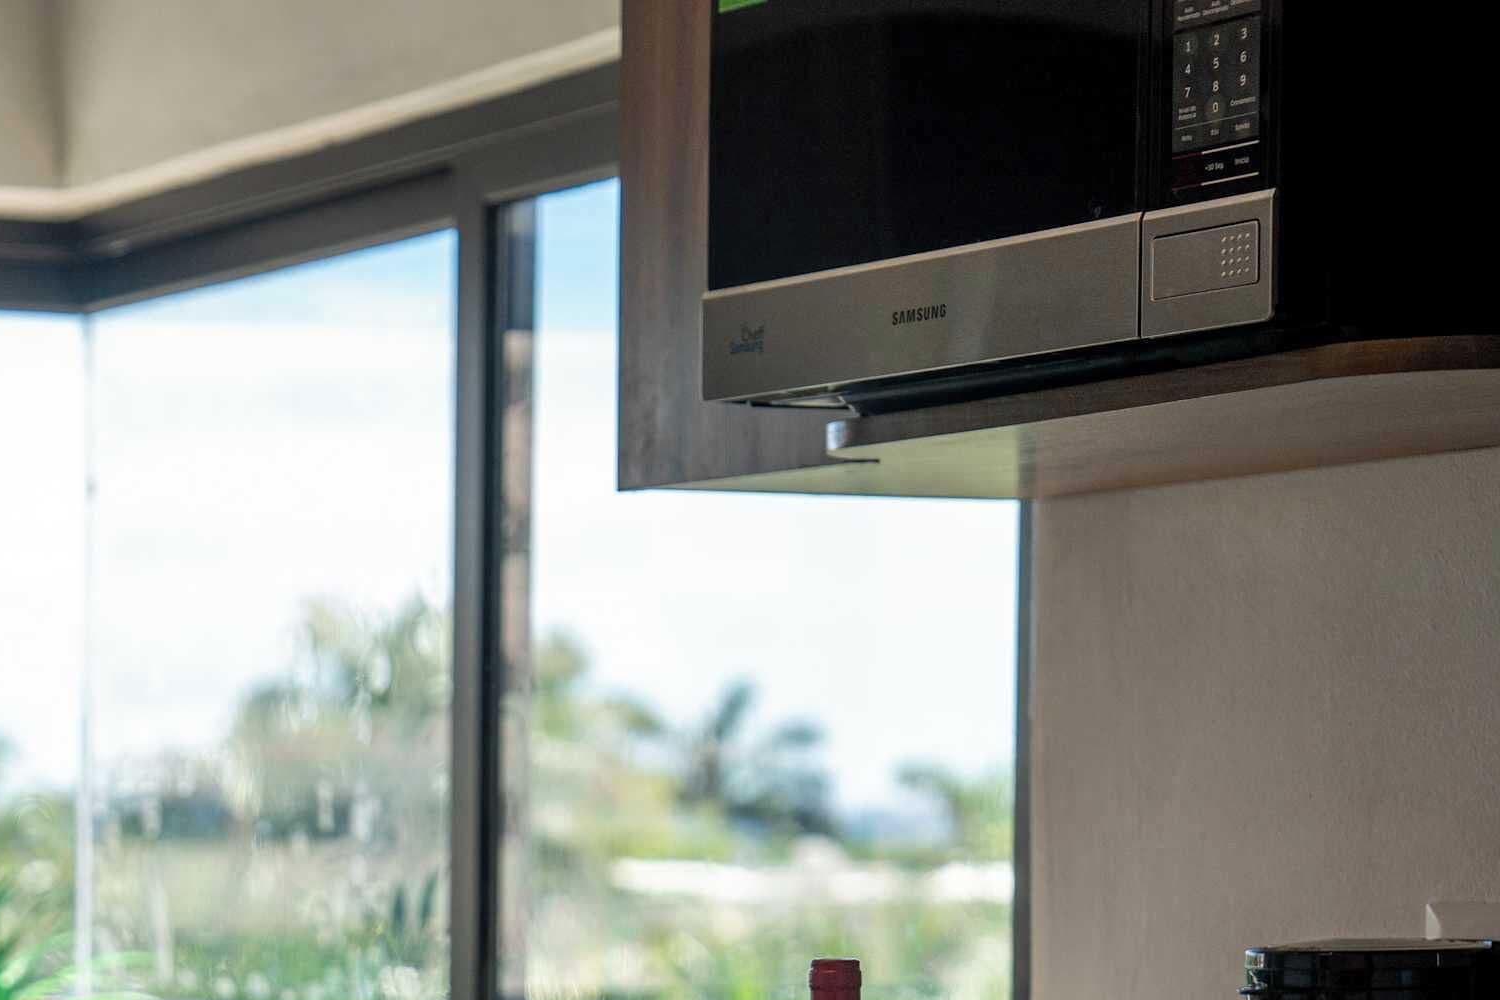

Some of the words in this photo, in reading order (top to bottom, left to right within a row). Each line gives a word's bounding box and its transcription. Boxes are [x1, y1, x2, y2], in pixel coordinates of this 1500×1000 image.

[1185, 41, 1191, 53] 1
[1213, 34, 1220, 46] 2
[1240, 27, 1248, 40] 3
[1184, 63, 1191, 75] 4
[1212, 57, 1220, 70] 5
[1240, 50, 1247, 63] 6
[1184, 86, 1192, 98] 7
[1212, 80, 1220, 92] 8
[1240, 74, 1247, 87] 9
[1212, 102, 1219, 113] 0
[891, 303, 948, 326] SAMSUNG
